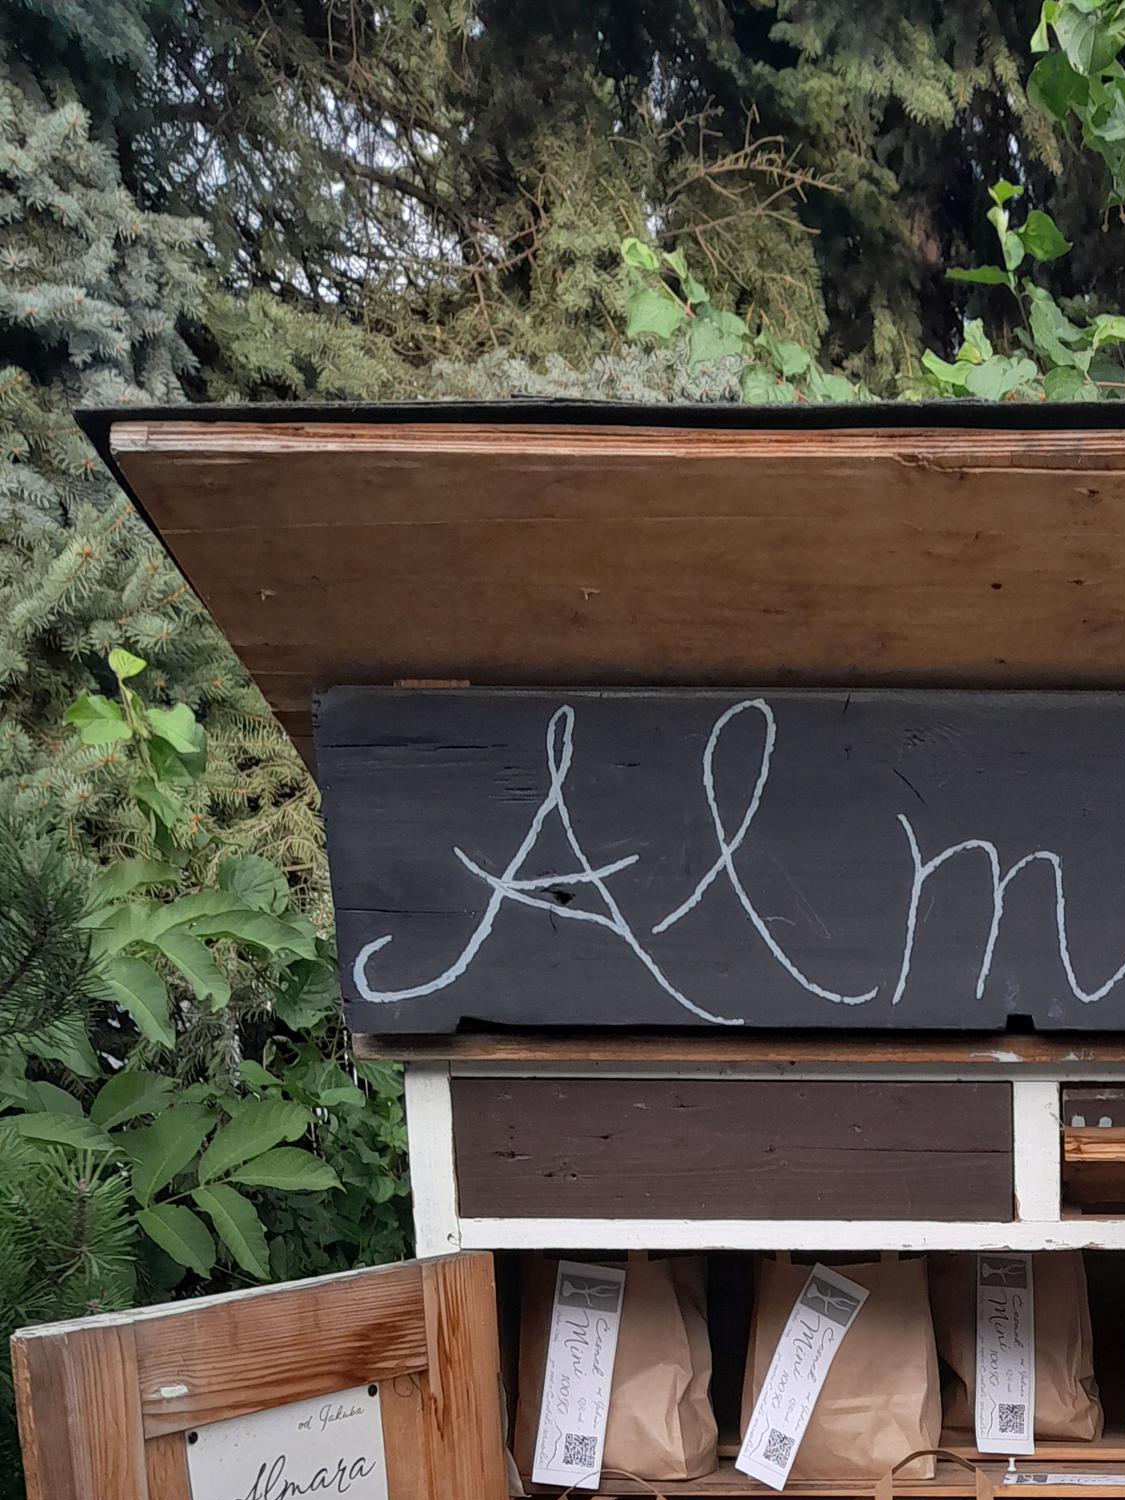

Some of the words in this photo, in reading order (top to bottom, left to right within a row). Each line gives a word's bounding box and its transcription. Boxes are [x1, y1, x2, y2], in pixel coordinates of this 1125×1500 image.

[563, 1309, 591, 1380] Mini
[793, 1314, 822, 1379] Mini
[987, 1291, 1008, 1353] Mini
[298, 1415, 311, 1430] od
[318, 1404, 365, 1432] Jakuba
